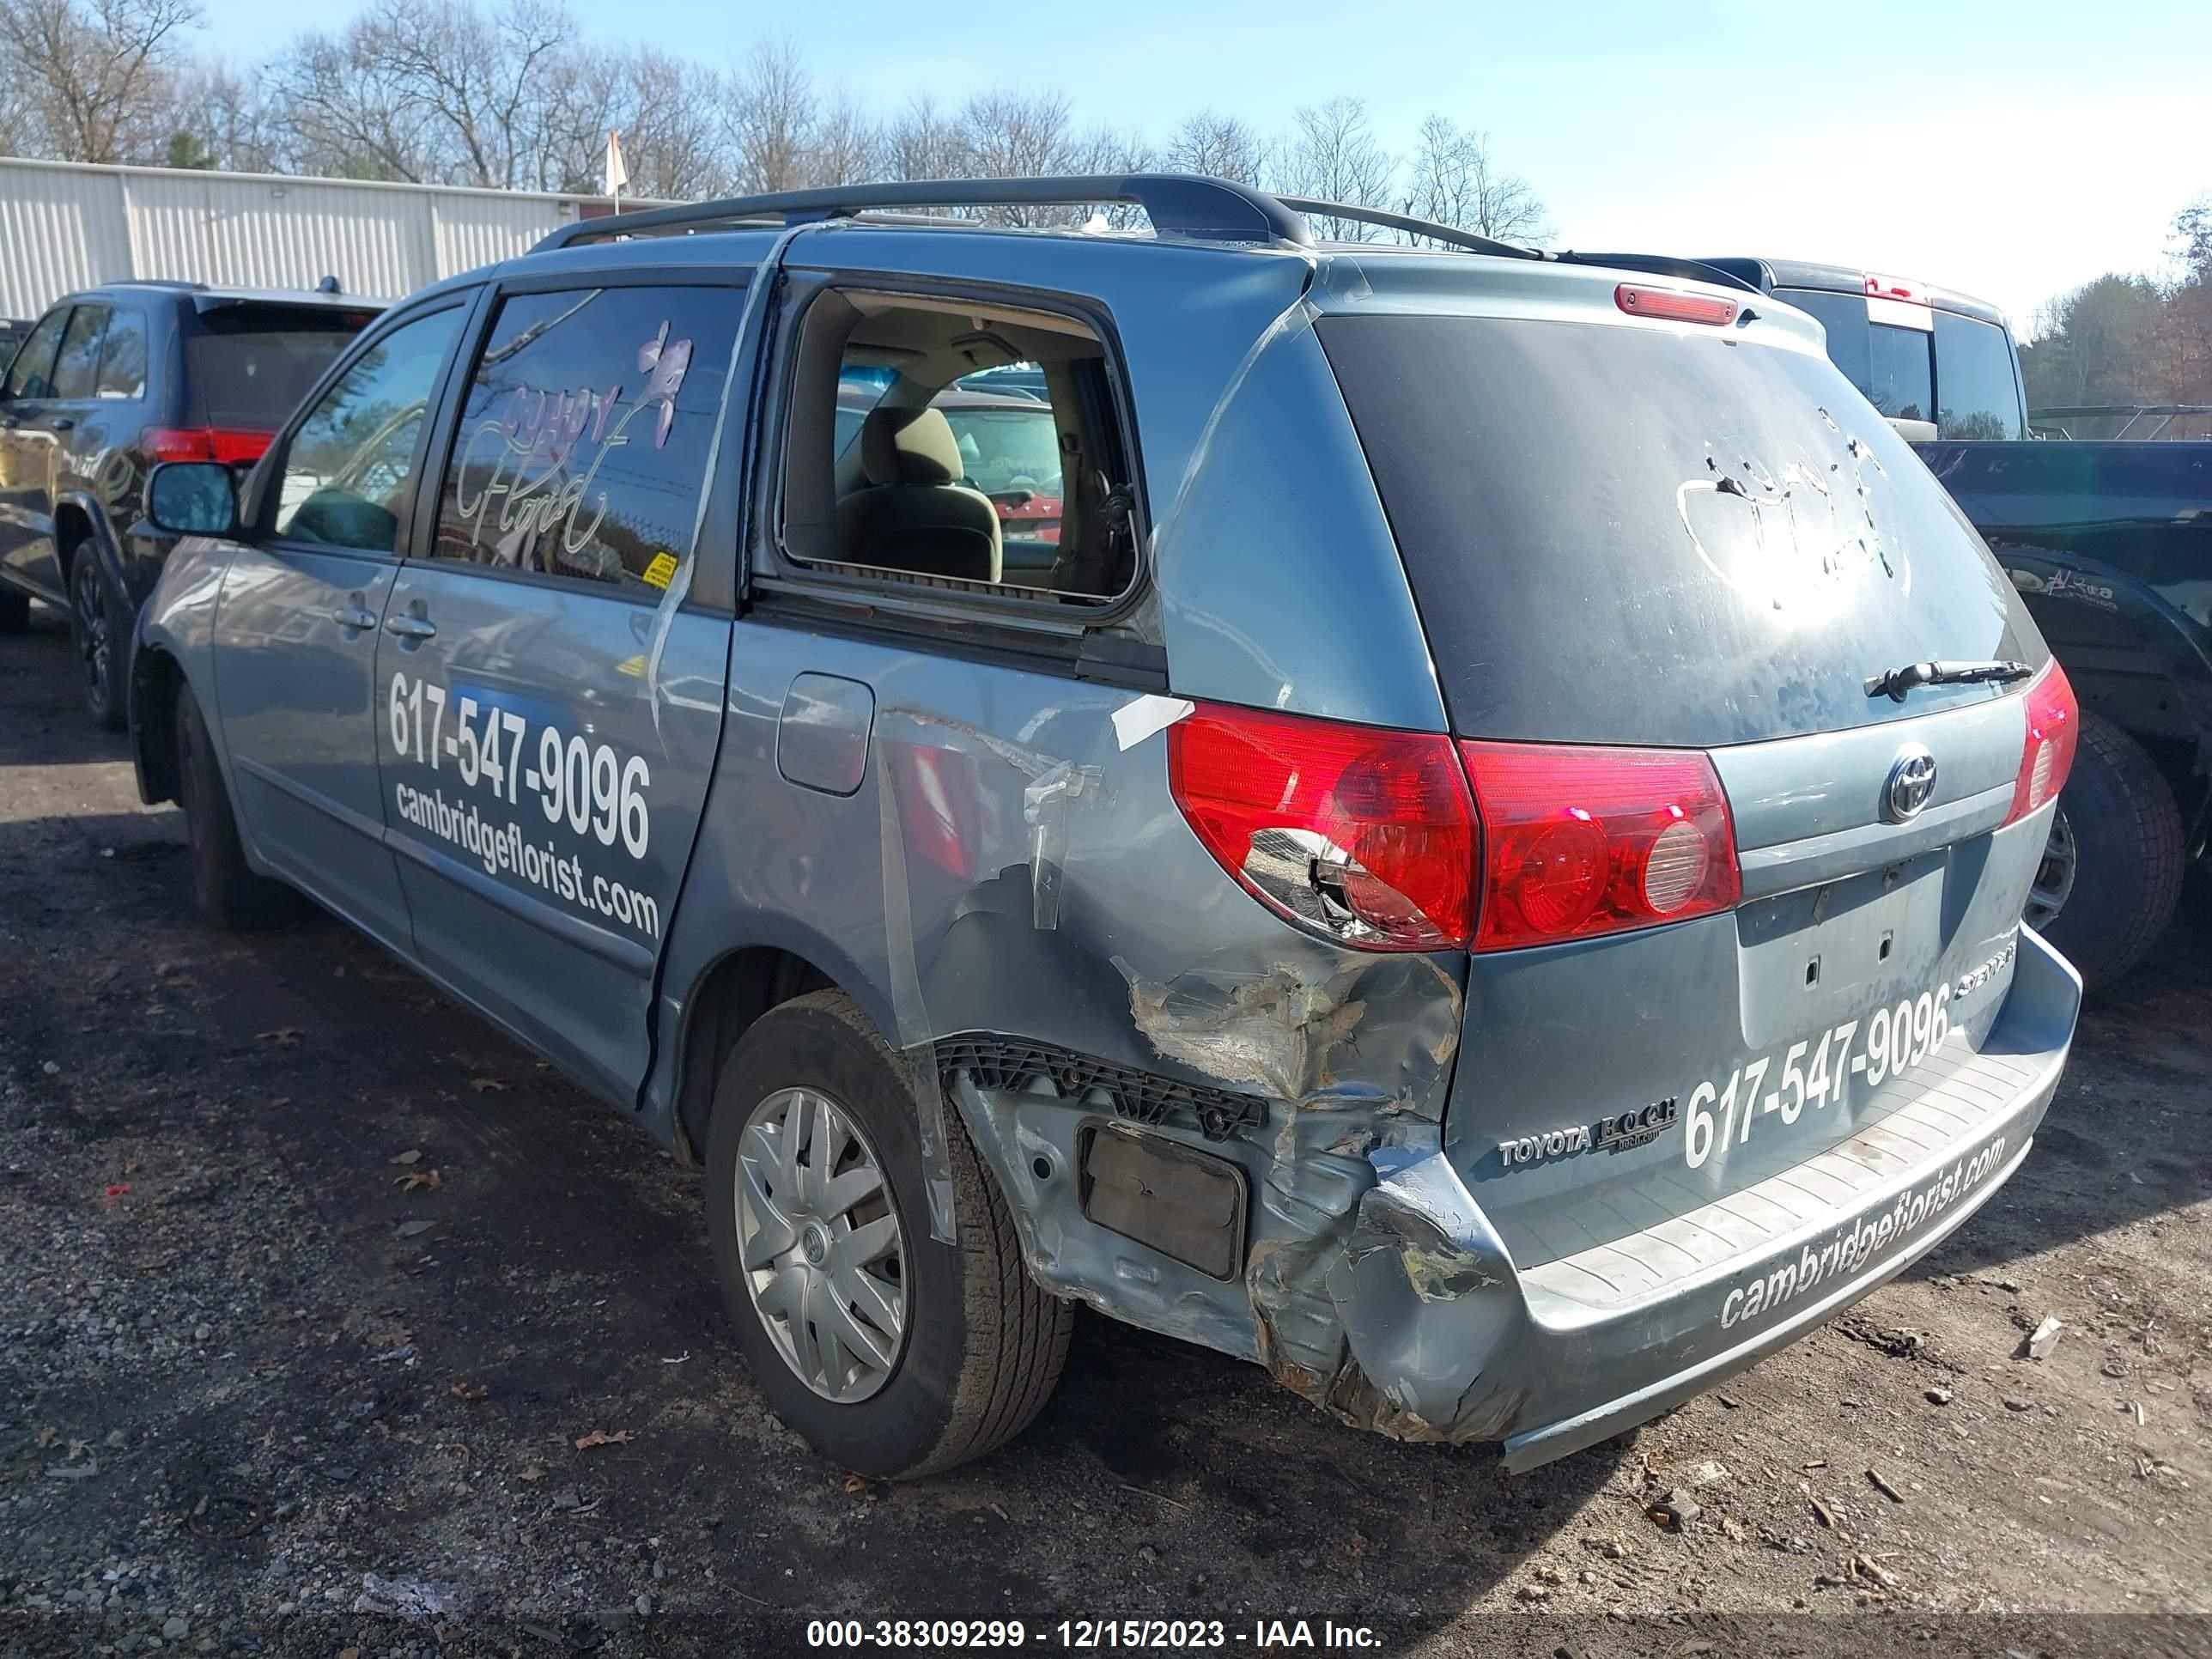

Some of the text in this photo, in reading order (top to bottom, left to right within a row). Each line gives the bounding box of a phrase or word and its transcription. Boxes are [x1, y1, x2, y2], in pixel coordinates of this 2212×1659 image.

[390, 672, 650, 860] 617-547-9096
[396, 782, 659, 940] cambridgeflorist.com
[1498, 1125, 1592, 1167] TOYOTA
[1599, 1096, 1679, 1141] BOCH
[1686, 982, 1950, 1169] 617-547-9096
[1720, 1133, 2006, 1329] cambridgeflorist.com
